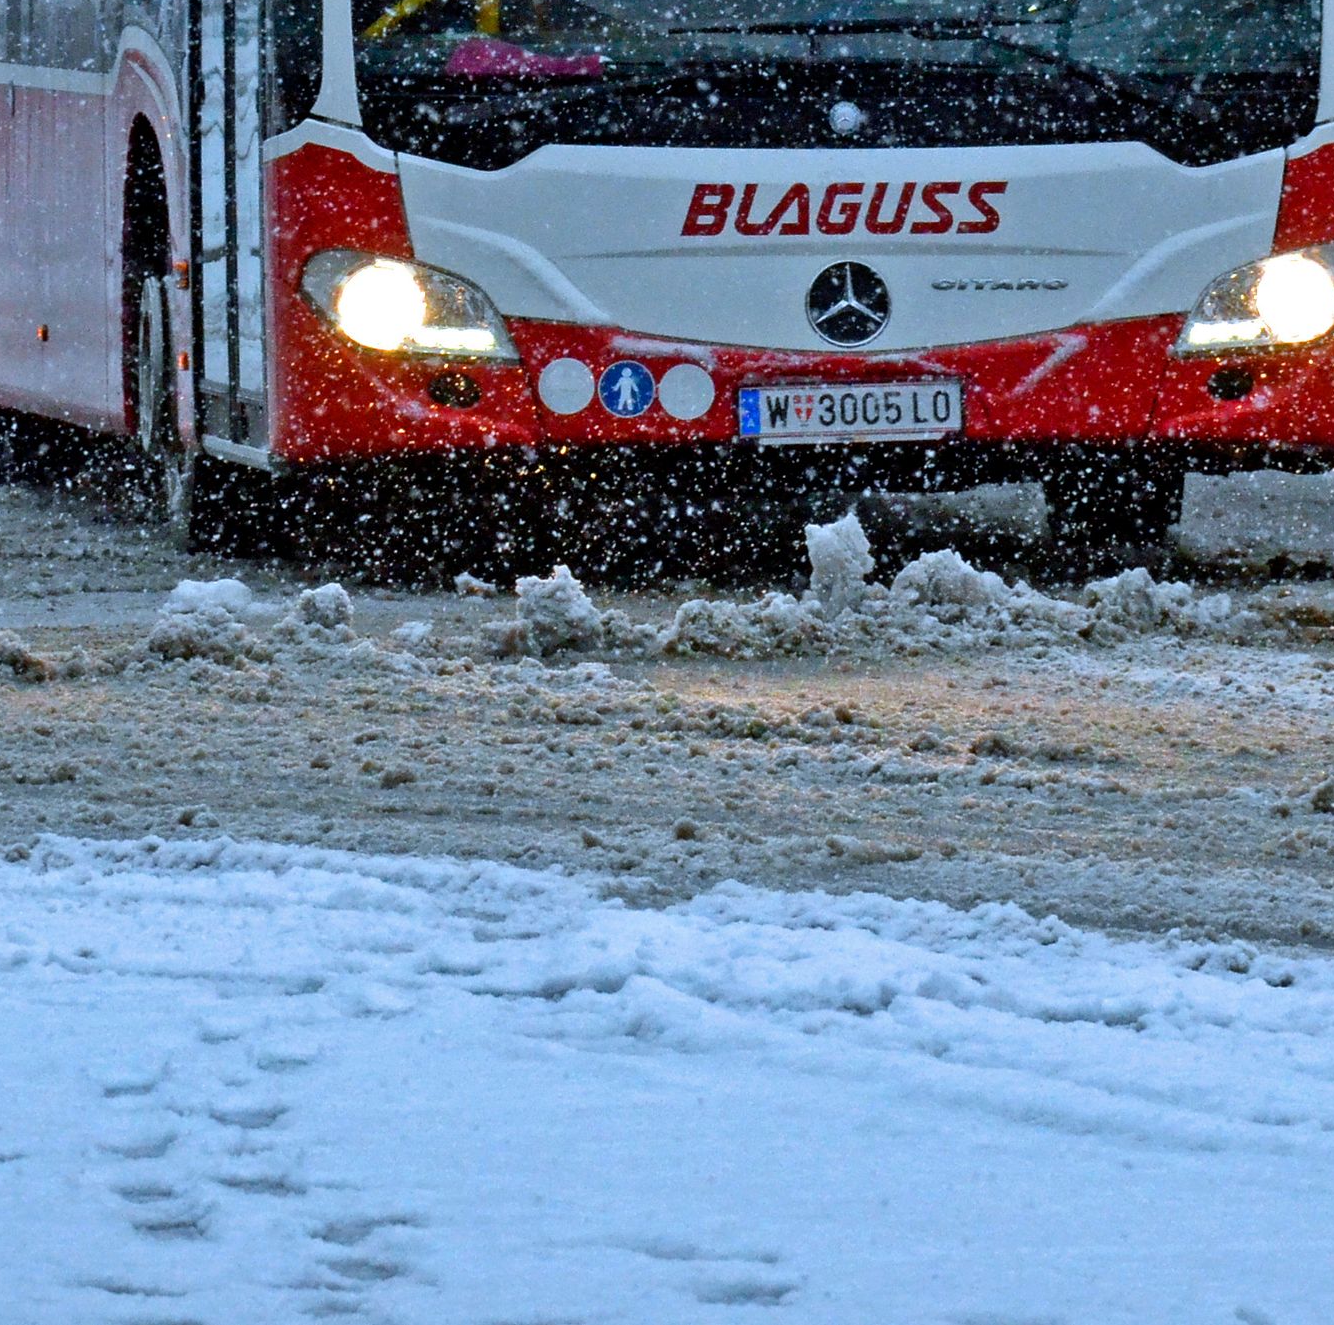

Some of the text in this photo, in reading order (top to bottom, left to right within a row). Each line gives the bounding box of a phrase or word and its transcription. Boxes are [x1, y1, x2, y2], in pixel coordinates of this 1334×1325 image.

[680, 181, 1009, 237] BLAGUSS
[931, 278, 1069, 291] CITARO
[767, 394, 790, 428] W
[818, 392, 902, 427] 3005
